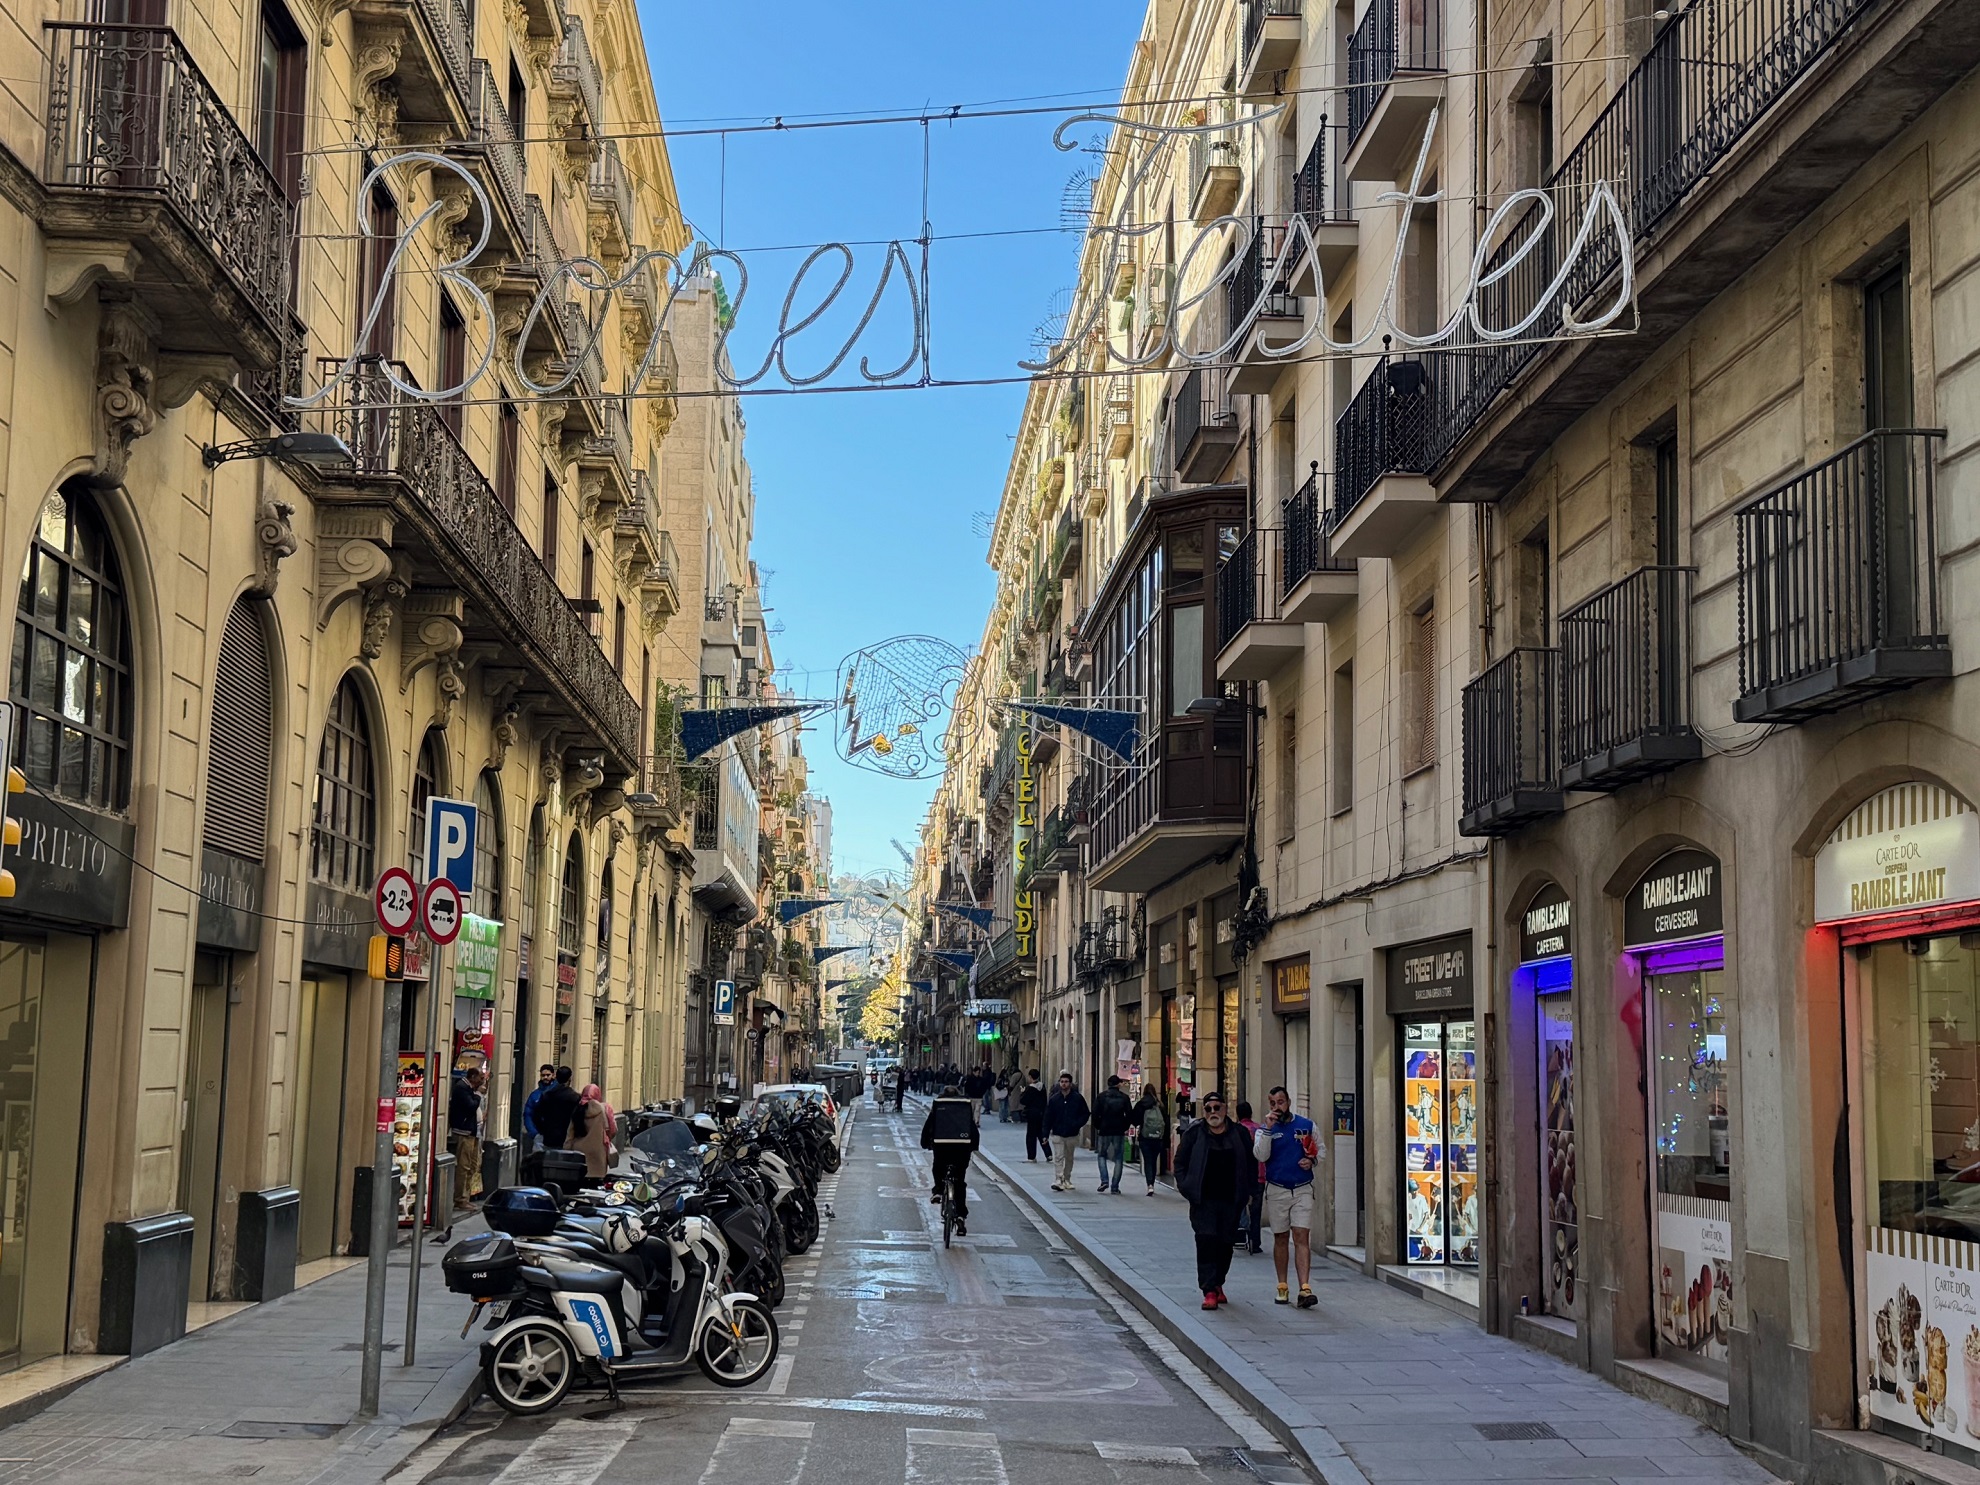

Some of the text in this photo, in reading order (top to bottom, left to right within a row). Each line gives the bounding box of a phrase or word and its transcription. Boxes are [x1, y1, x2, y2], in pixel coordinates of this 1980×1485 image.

[1018, 103, 1635, 373] Festes
[15, 816, 106, 876] PRIETO
[437, 811, 467, 878] P
[1876, 847, 1899, 866] CARTE
[1643, 866, 1713, 910] RAMBLEJANT
[1851, 867, 1946, 912] RAMBLEJANT
[315, 902, 358, 937] PRIETO
[1655, 909, 1698, 933] CERVESERIA
[1536, 935, 1565, 956] CAFETERIA
[1286, 964, 1311, 992] TABAC
[1404, 950, 1465, 985] STREET WEAR
[718, 984, 731, 1011] P
[472, 1271, 488, 1279] 0145
[1935, 1276, 1954, 1293] CARTE
[588, 1305, 603, 1334] cooltra
